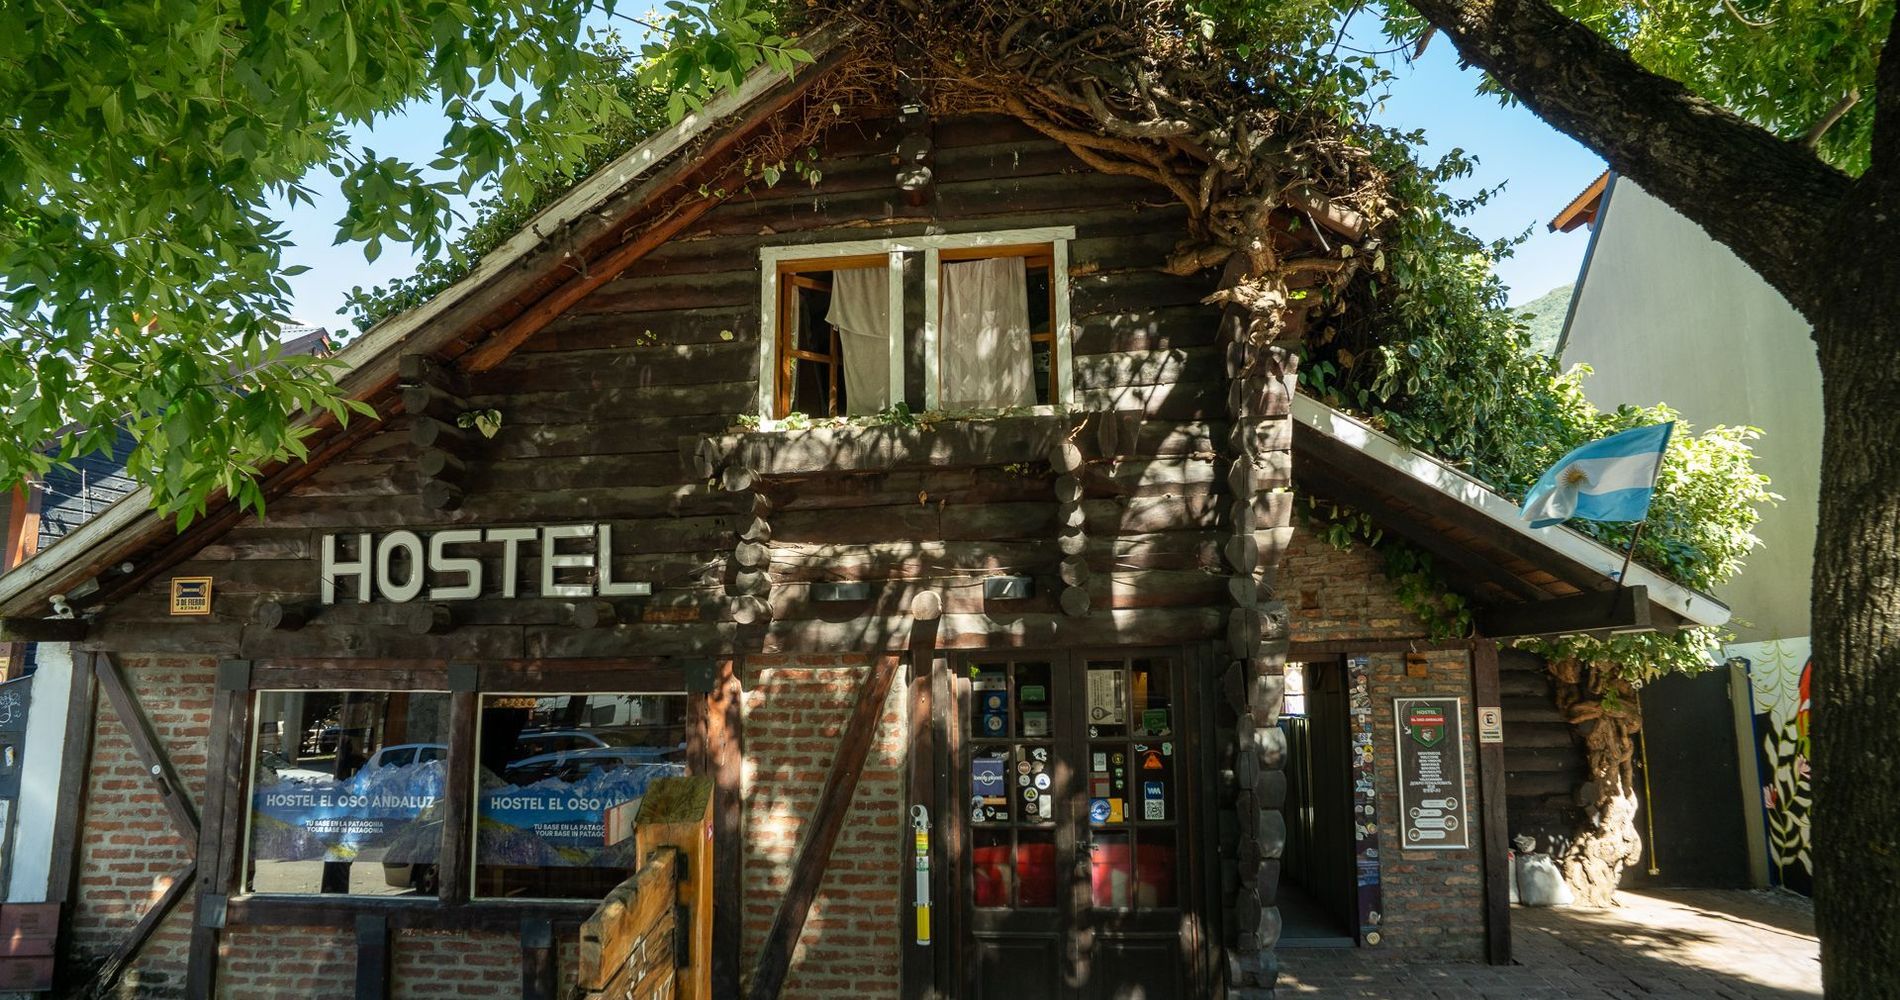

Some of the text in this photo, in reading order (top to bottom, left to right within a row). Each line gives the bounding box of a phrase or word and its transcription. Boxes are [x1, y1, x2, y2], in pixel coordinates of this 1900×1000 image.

[321, 523, 652, 605] HOSTEL
[181, 598, 187, 606] DE
[1486, 714, 1494, 724] E
[266, 794, 435, 809] HOSTEL EL OSO ANDALUZ
[491, 797, 630, 811] HOSTEL EL OSO AN
